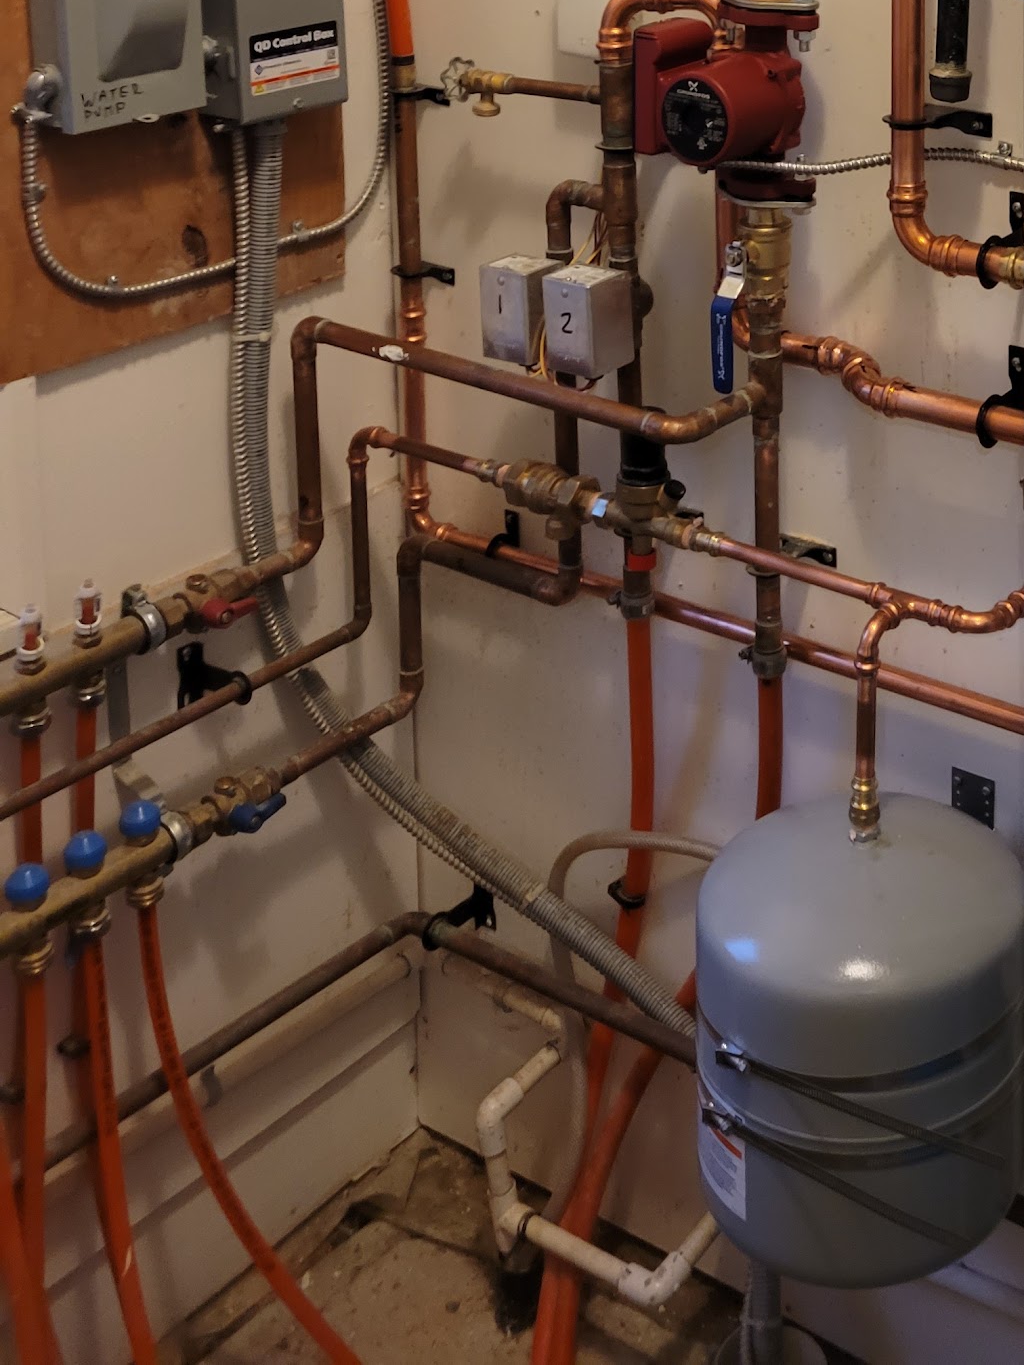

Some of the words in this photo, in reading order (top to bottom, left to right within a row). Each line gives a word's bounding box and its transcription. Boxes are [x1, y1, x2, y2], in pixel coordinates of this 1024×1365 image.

[253, 39, 272, 54] QD
[272, 31, 312, 49] Control
[313, 29, 335, 42] Box
[81, 82, 144, 108] WATER
[560, 312, 574, 335] 2
